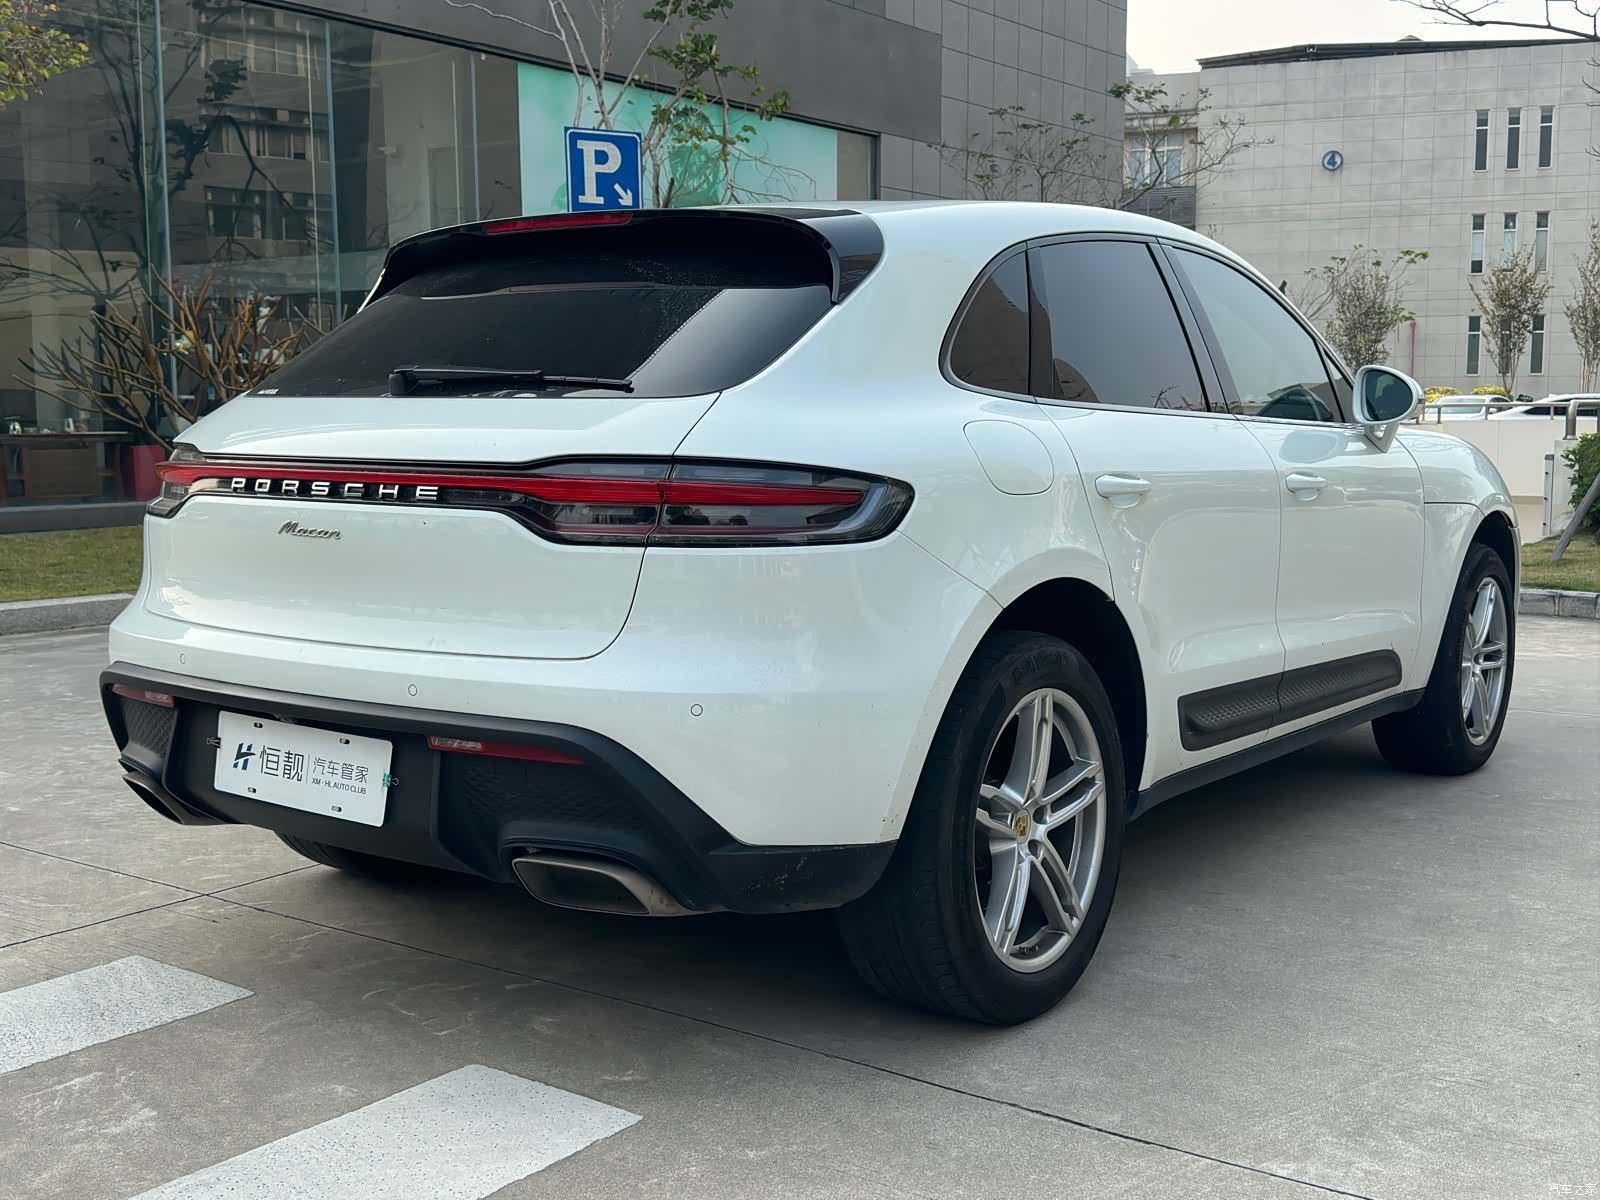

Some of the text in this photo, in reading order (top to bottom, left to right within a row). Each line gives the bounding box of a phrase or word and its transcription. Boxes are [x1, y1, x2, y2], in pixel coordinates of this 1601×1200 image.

[577, 139, 622, 205] P
[231, 477, 439, 500] PORSCHE
[278, 520, 341, 540] Macan
[259, 745, 305, 782] 恒靓
[313, 756, 369, 784] 汽车管家
[333, 781, 350, 792] AUTO
[350, 785, 367, 795] CLUB
